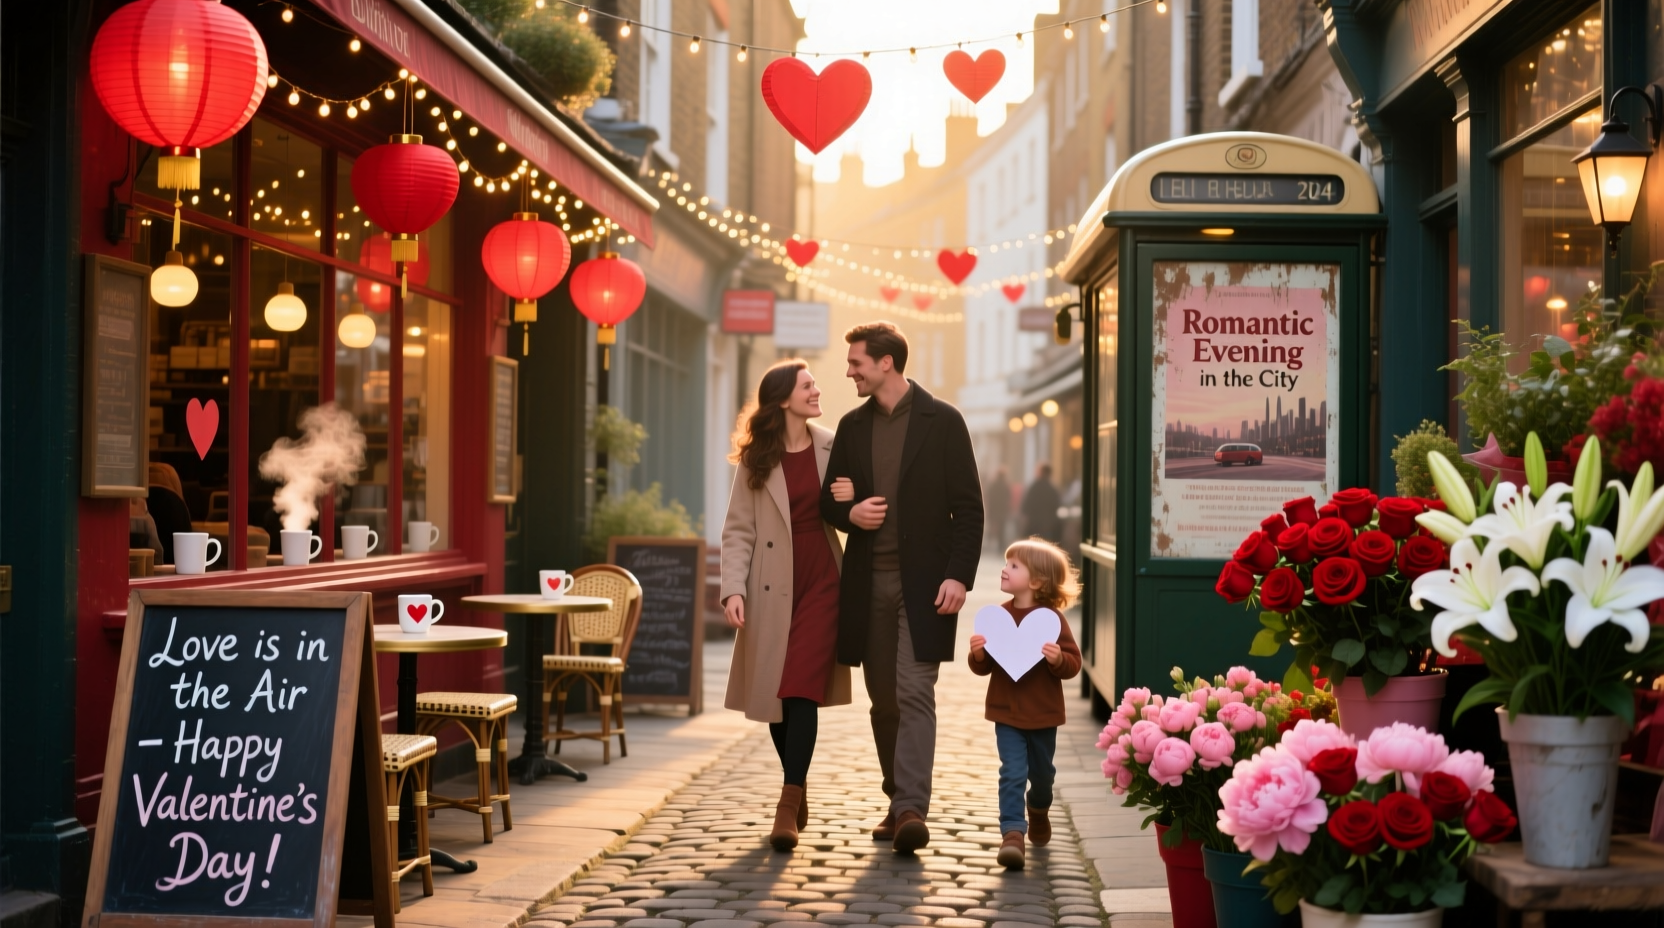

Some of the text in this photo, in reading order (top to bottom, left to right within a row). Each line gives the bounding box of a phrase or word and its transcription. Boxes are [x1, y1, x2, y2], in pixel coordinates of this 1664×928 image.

[1182, 308, 1314, 336] Romantic
[1192, 338, 1304, 370] Evening
[1200, 368, 1299, 392] in the City
[148, 616, 329, 668] Love is in
[170, 668, 308, 713] the Air
[174, 718, 283, 783] Happy
[133, 771, 318, 828] Valentine's
